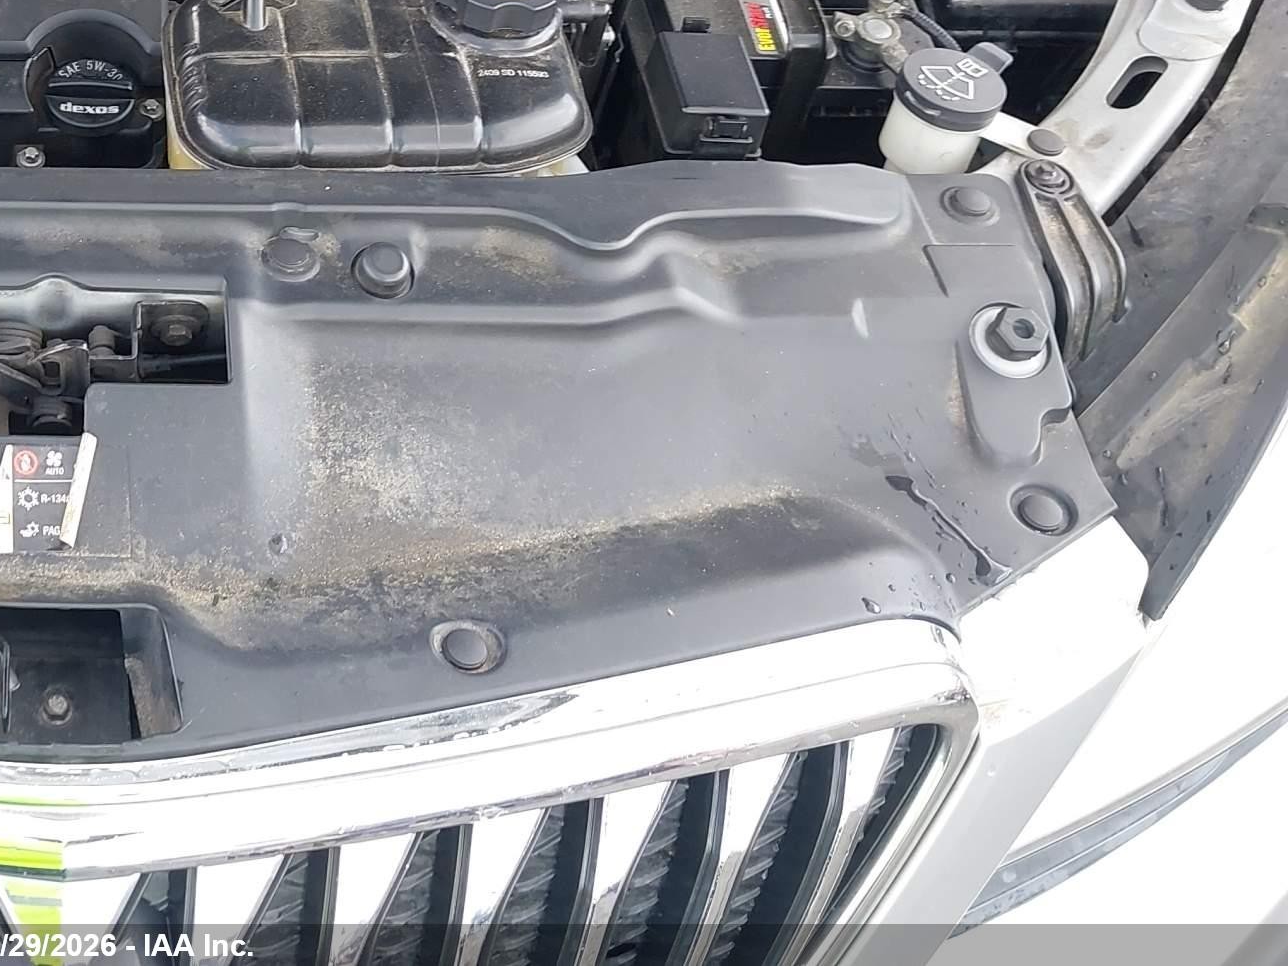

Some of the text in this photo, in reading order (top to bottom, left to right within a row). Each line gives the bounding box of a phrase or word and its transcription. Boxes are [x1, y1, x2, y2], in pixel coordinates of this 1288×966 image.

[58, 61, 81, 78] SAE
[59, 101, 120, 114] dexos
[45, 466, 65, 475] AUTO
[42, 525, 61, 536] PAG
